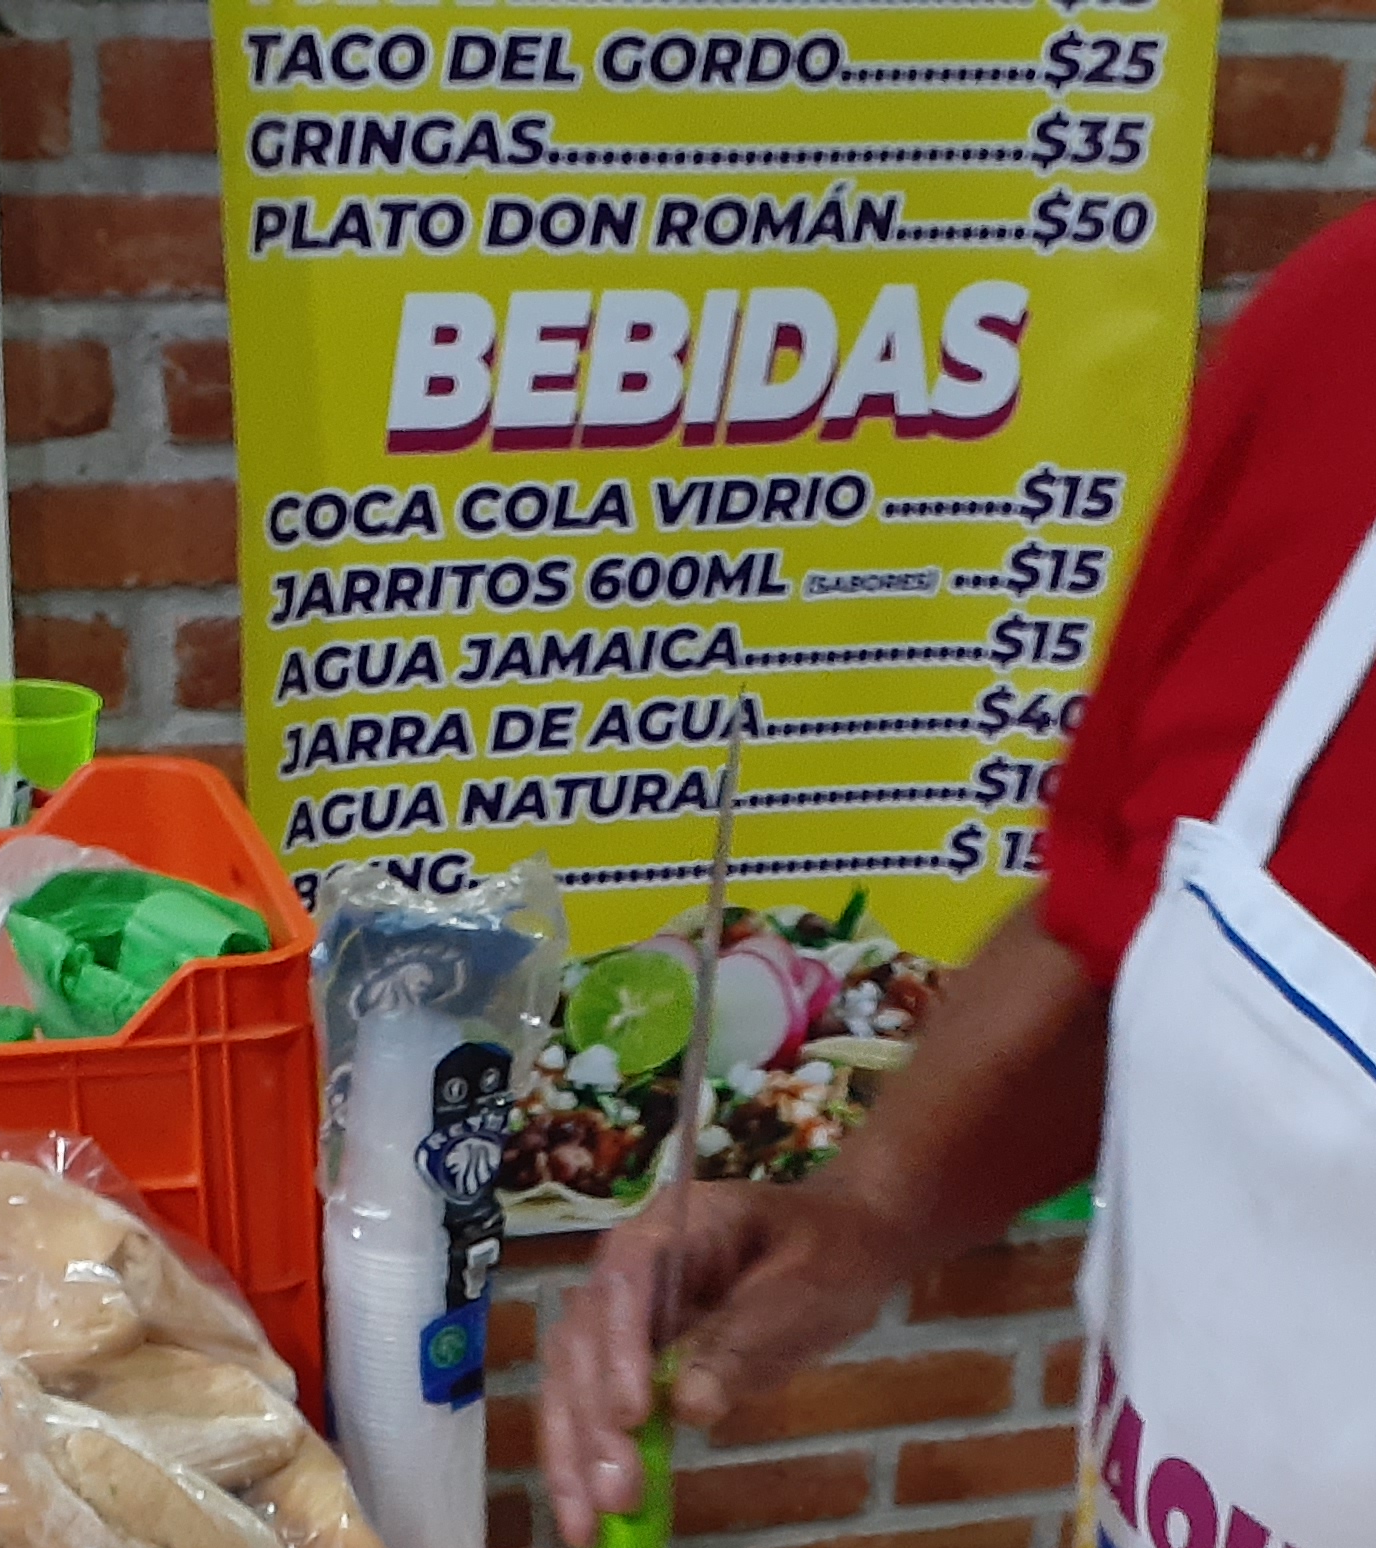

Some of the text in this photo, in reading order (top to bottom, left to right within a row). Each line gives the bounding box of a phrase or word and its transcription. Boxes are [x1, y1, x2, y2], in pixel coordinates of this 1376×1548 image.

[249, 34, 426, 83] TACO
[450, 37, 576, 83] DEL
[1046, 32, 1159, 90] $25
[1032, 113, 1145, 170] $35
[256, 202, 465, 254] PLATO
[489, 202, 638, 247] DON
[1034, 193, 1148, 248] $50
[386, 281, 1029, 455] BEBIDAS
[271, 468, 1117, 546] COCA COLA VIDRIO $15
[273, 562, 570, 625] JARRITOS
[591, 554, 786, 603] 600ML
[1008, 544, 1104, 594] $15
[279, 643, 439, 701] AGUA
[992, 616, 1086, 667] $15
[282, 715, 469, 775] JARRA
[493, 709, 575, 752] DE
[287, 788, 441, 850] AGUA
